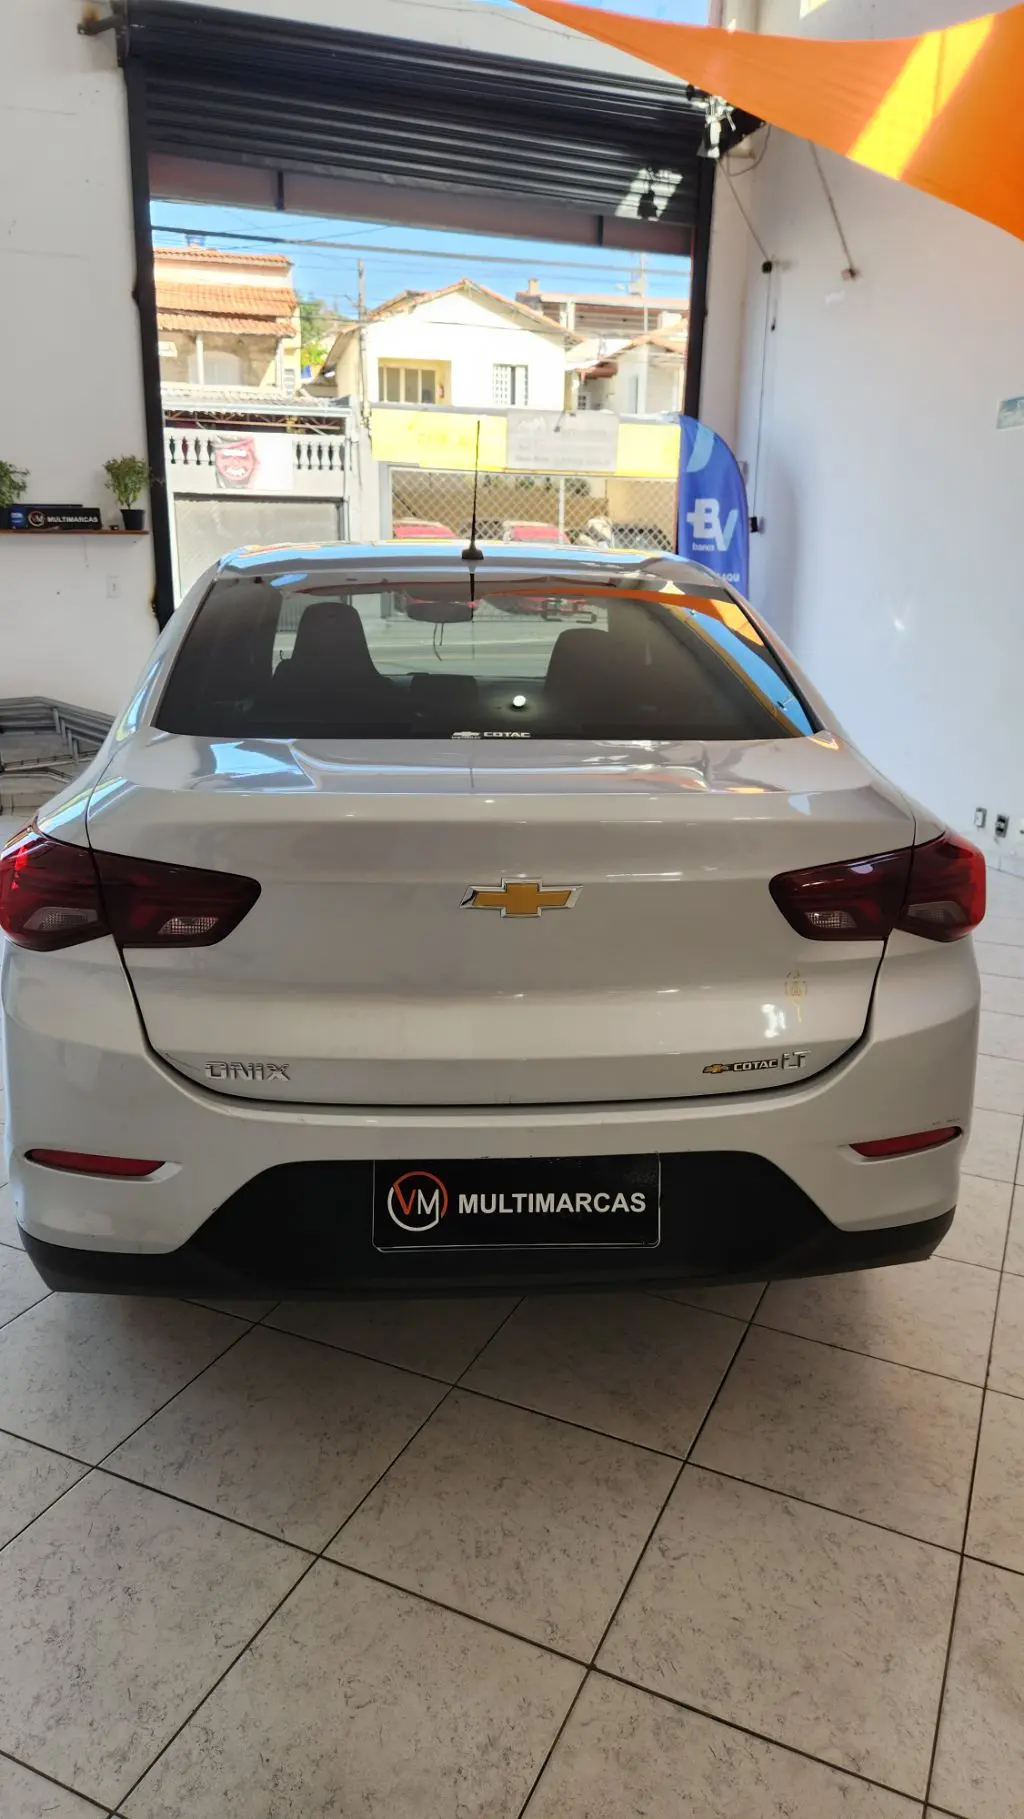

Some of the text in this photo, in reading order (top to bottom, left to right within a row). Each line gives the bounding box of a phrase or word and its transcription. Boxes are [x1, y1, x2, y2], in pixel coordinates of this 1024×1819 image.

[733, 1060, 777, 1071] COTAC
[782, 1050, 811, 1070] LT
[205, 1061, 291, 1081] ONIX
[391, 1182, 647, 1222] VM MULTIMARCAS
